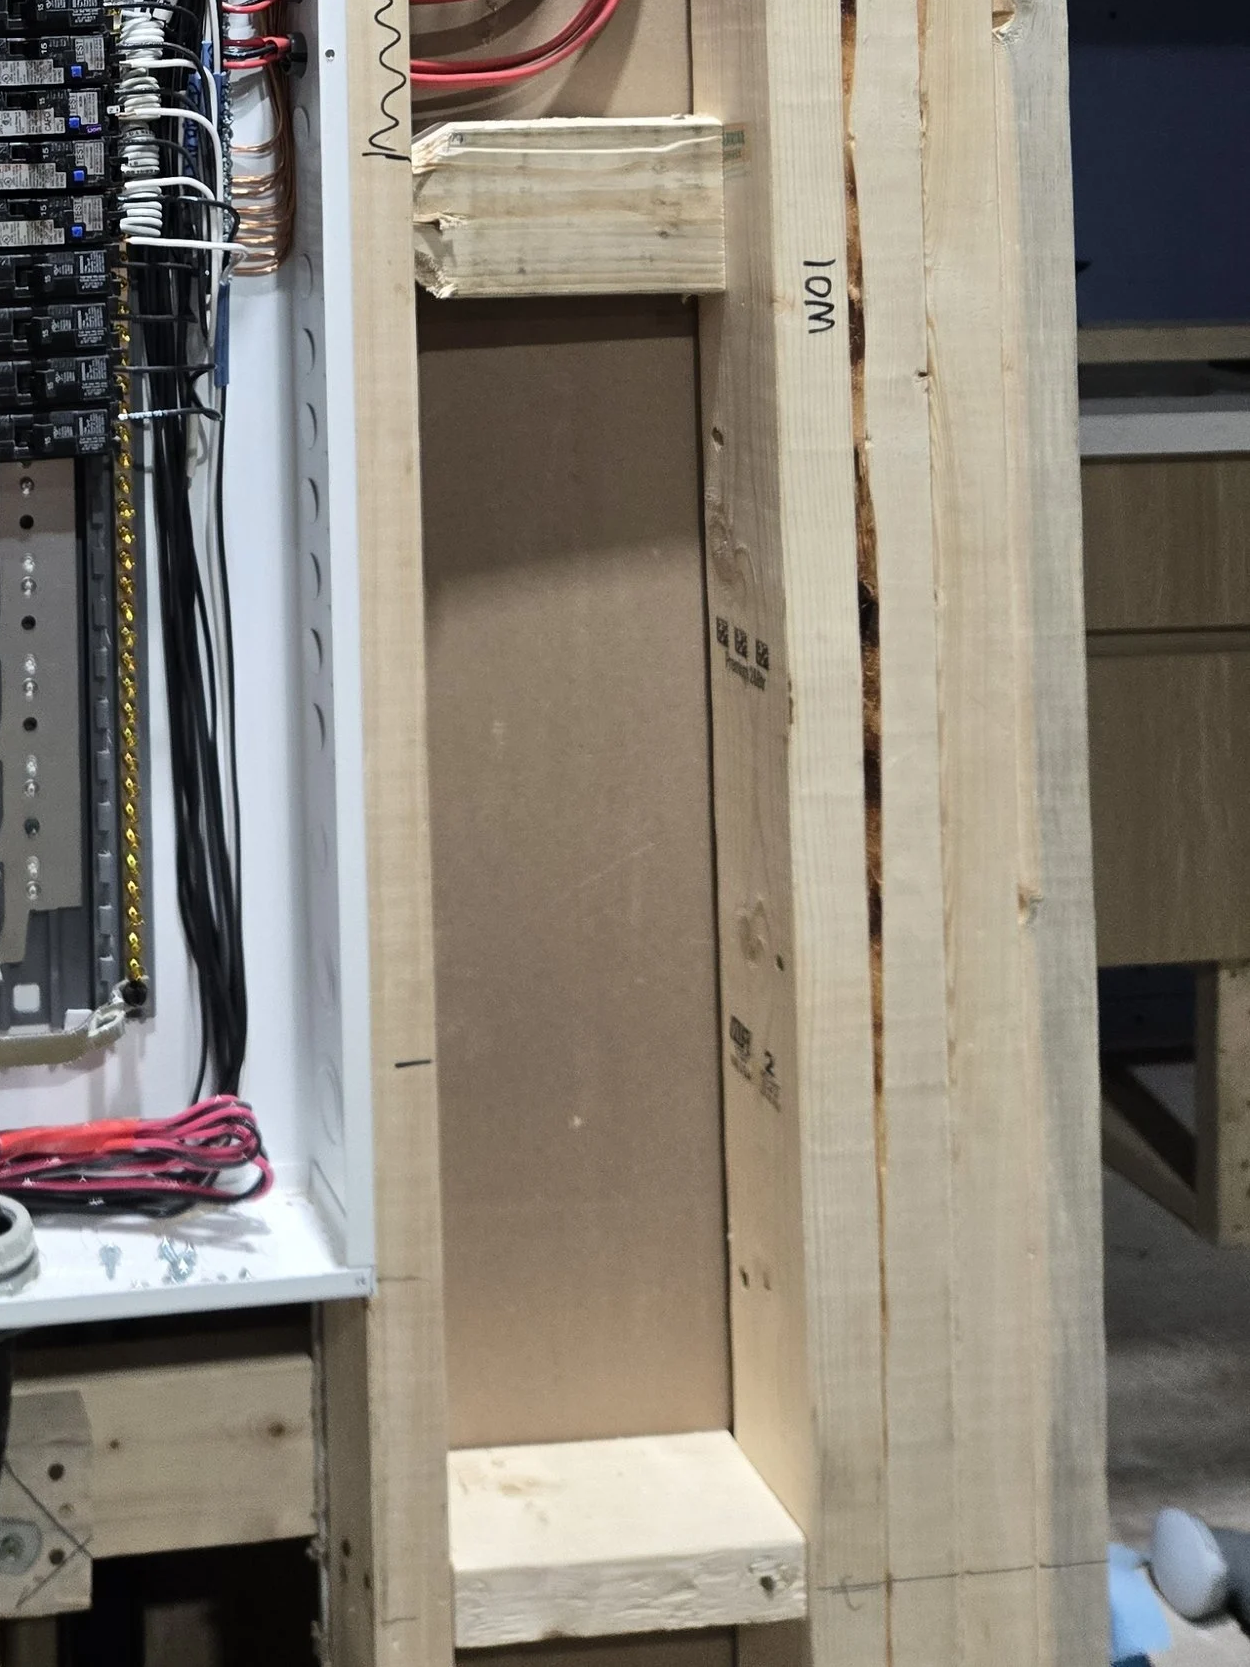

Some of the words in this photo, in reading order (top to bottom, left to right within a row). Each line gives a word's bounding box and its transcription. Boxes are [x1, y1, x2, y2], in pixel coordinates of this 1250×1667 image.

[40, 42, 48, 54] 15
[75, 39, 84, 62] TEST
[69, 93, 77, 116] TEST
[76, 143, 84, 166] TEST
[40, 204, 48, 216] 15
[74, 199, 82, 222] TEST
